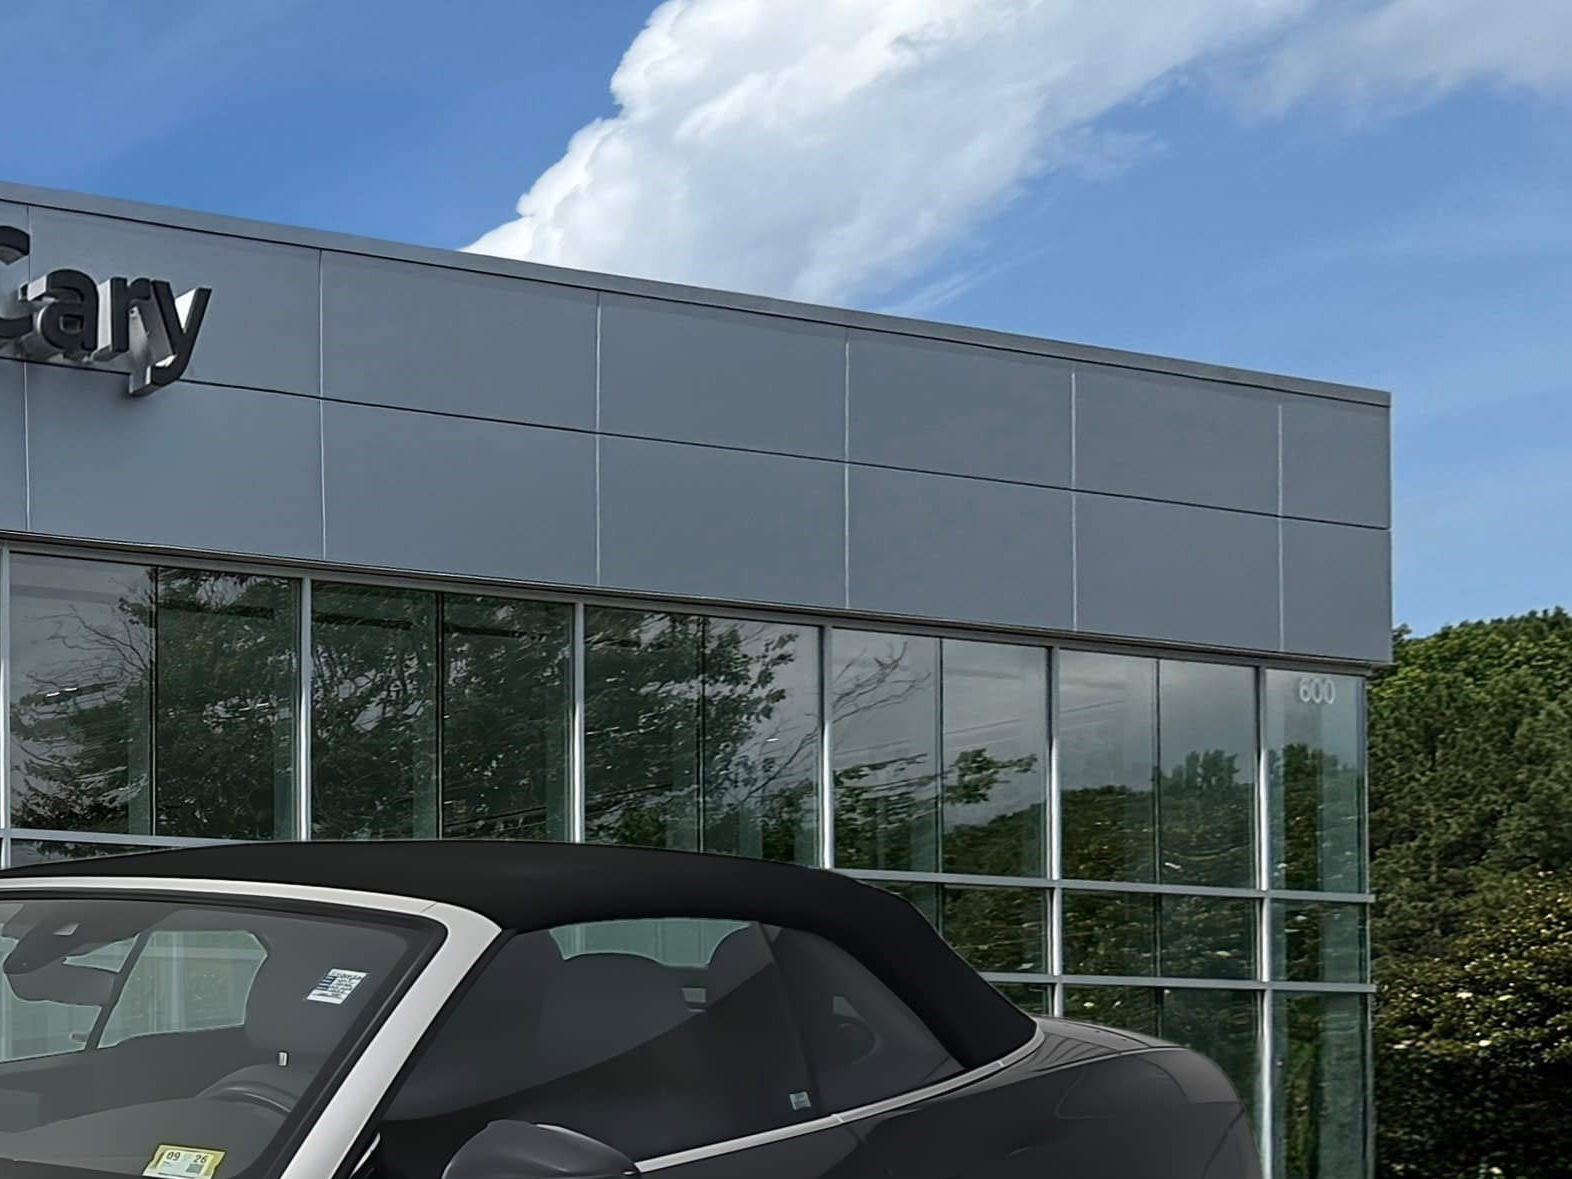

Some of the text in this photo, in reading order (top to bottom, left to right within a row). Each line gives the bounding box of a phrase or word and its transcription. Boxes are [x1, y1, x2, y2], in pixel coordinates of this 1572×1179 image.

[1299, 678, 1336, 704] 600
[166, 1151, 209, 1164] 09 26
